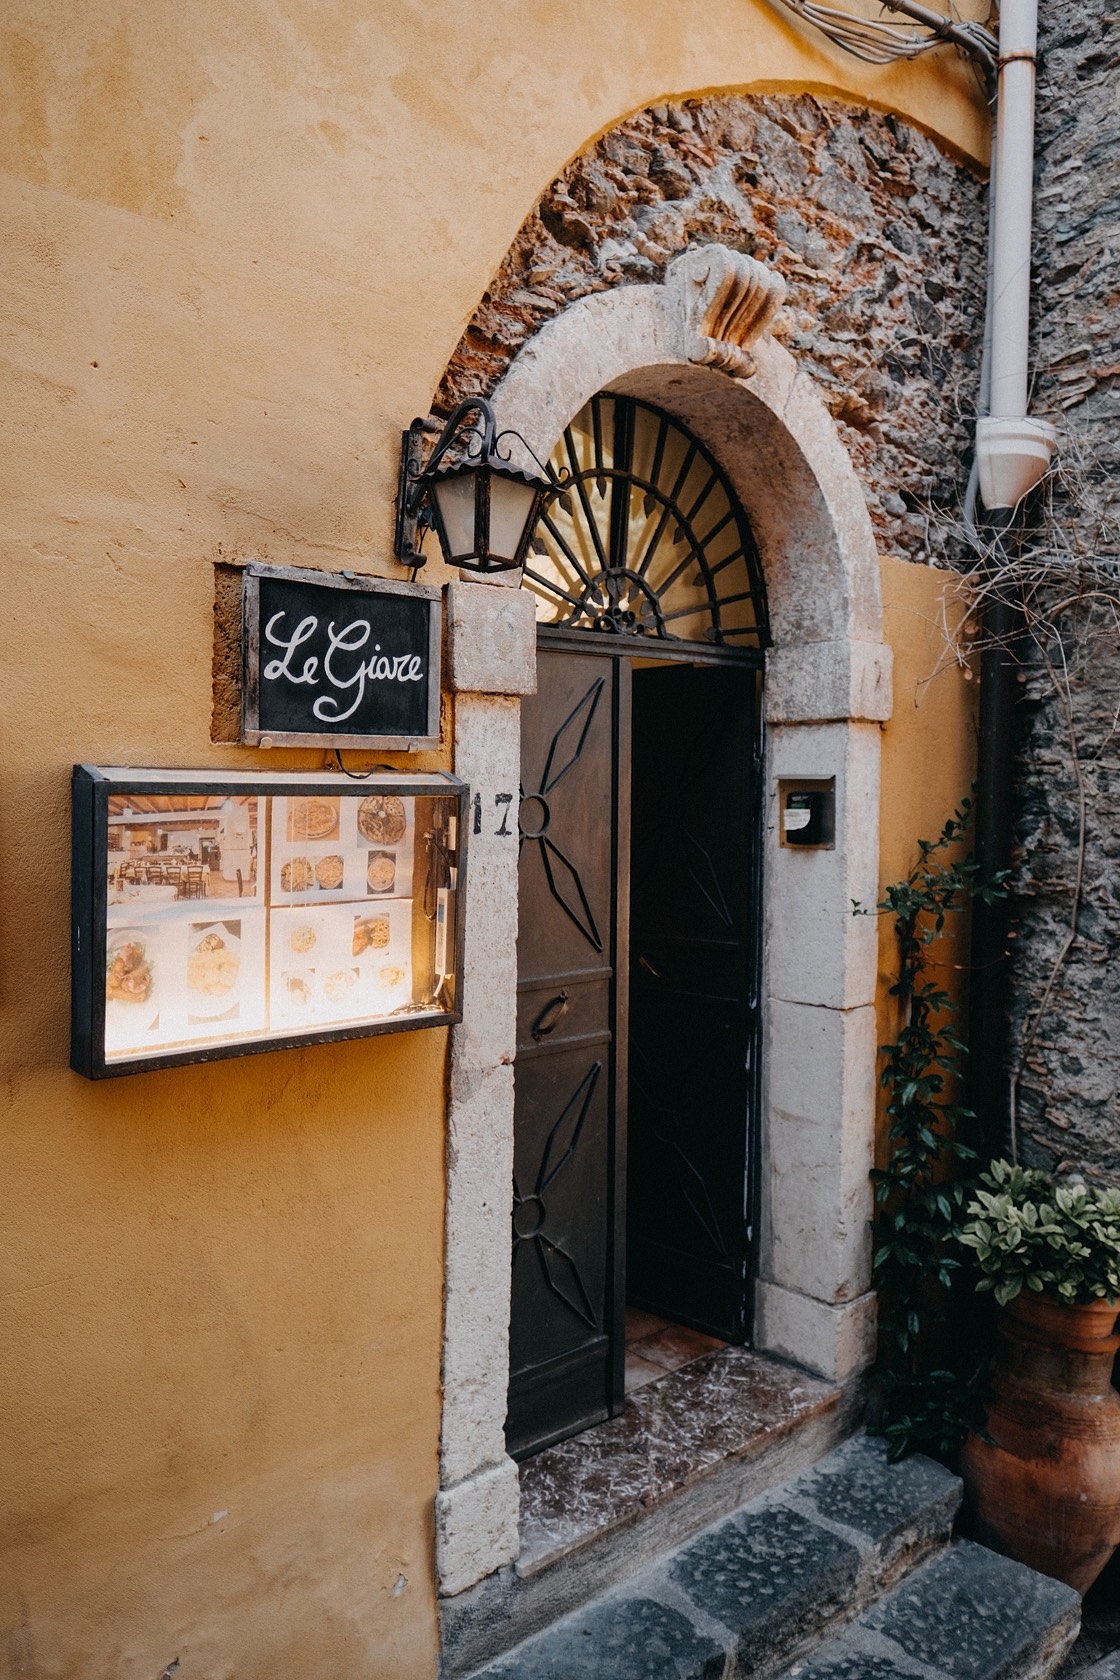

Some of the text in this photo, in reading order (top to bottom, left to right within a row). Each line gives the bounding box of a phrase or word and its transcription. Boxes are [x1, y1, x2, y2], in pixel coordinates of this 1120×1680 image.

[263, 610, 424, 722] Le Giare
[473, 792, 513, 836] 17
